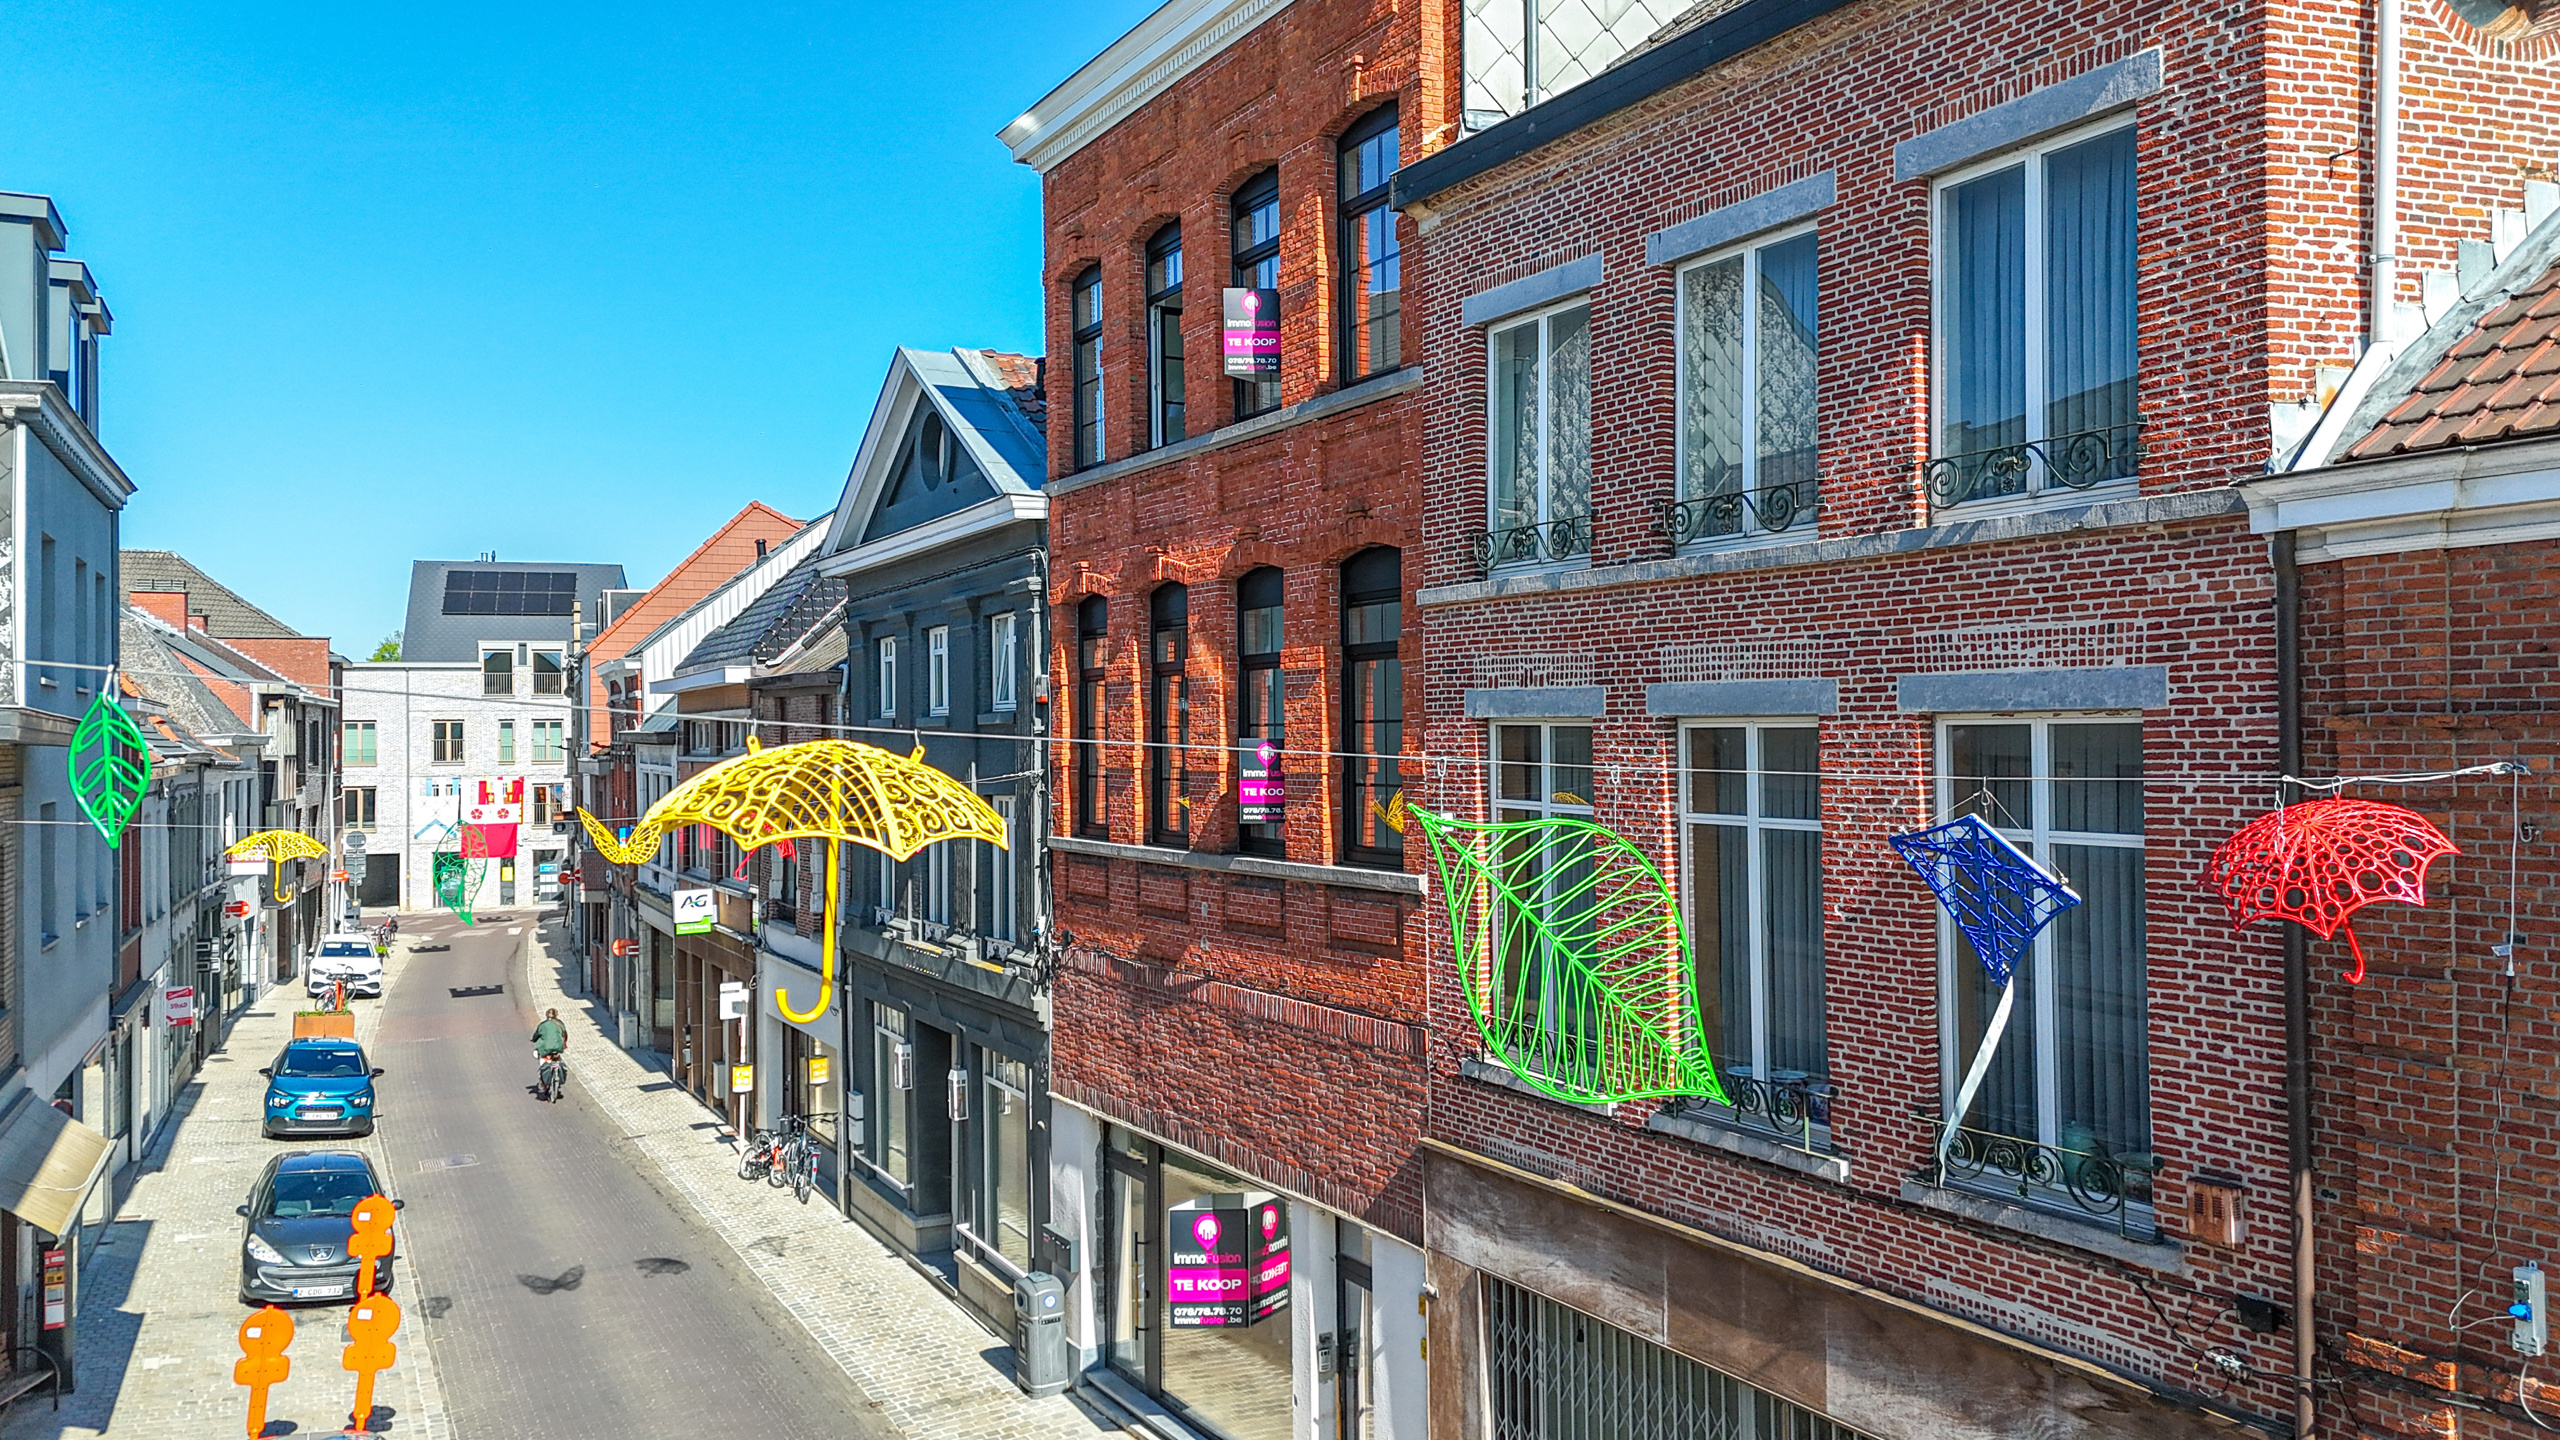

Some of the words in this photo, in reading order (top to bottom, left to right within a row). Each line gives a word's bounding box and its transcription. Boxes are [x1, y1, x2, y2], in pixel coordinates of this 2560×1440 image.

[1227, 338, 1242, 346] TE
[1244, 338, 1277, 346] KOOP
[1243, 788, 1257, 796] TE
[680, 894, 708, 909] AG
[1173, 1252, 1242, 1265] ImmoFusion
[1174, 1279, 1194, 1291] TE
[1197, 1278, 1242, 1291] KOOP
